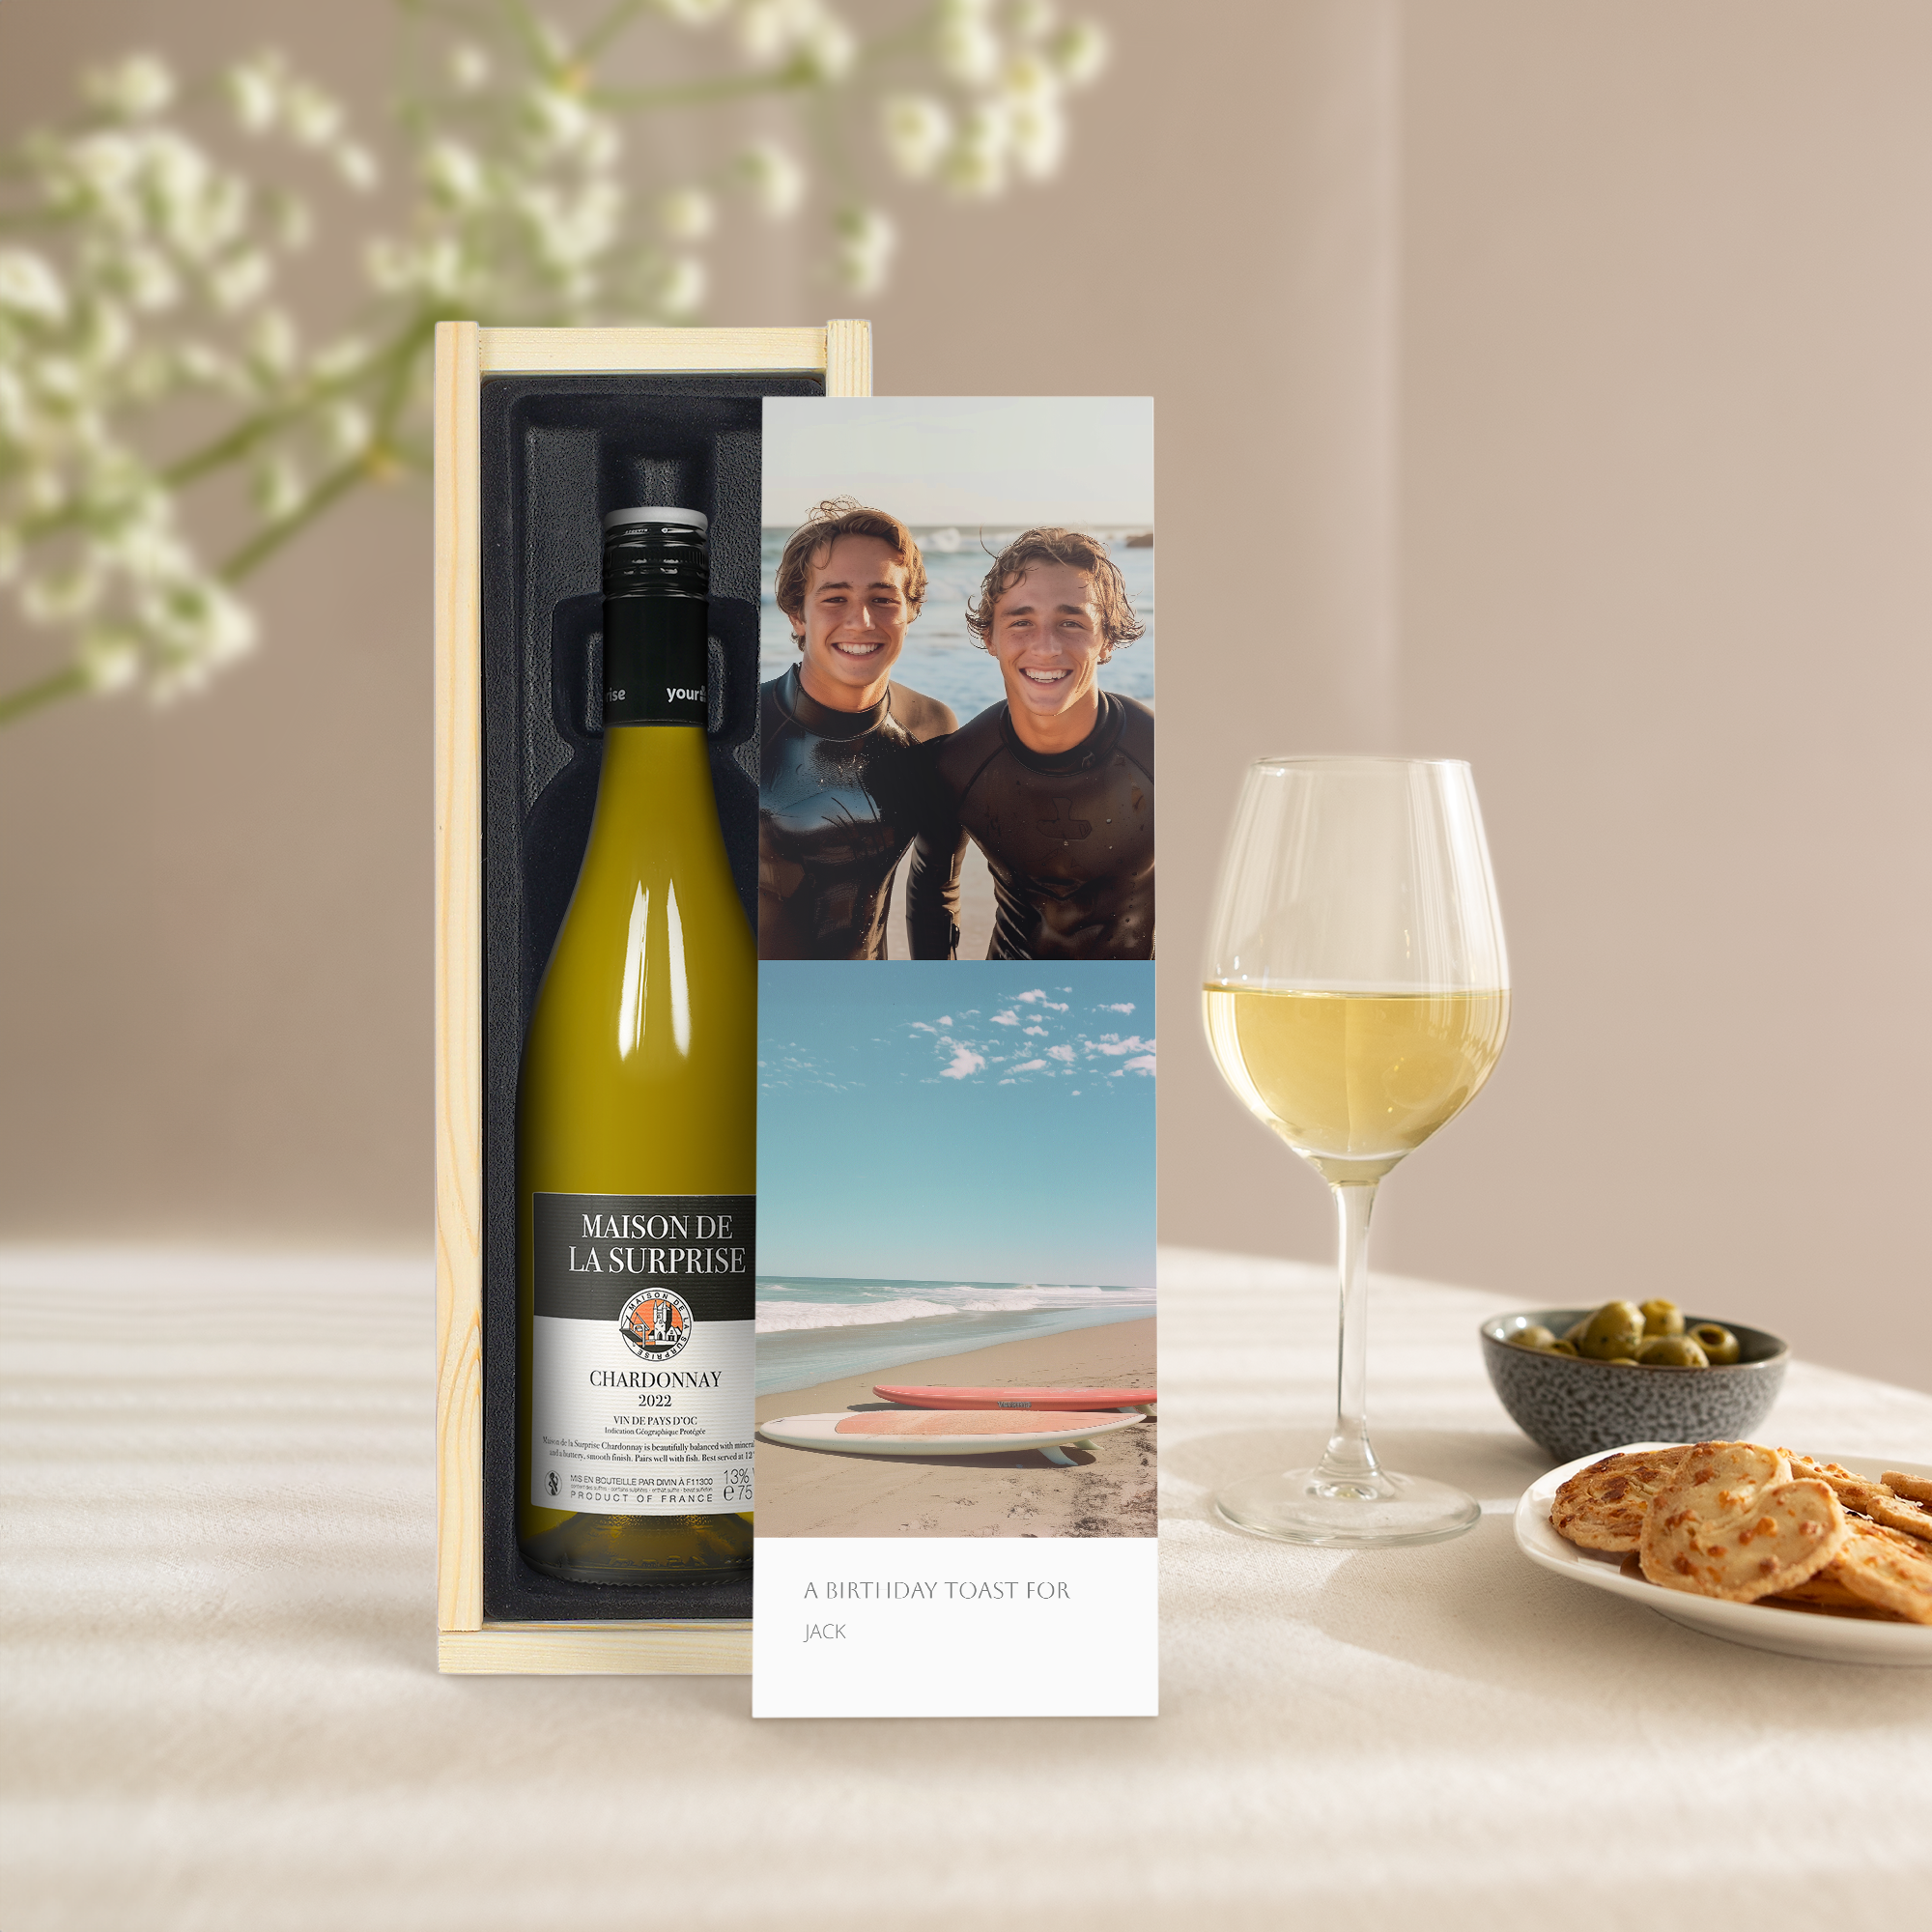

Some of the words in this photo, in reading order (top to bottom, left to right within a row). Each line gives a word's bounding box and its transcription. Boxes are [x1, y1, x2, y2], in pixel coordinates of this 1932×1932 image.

[667, 687, 700, 703] your
[582, 1214, 690, 1239] MAISON
[696, 1214, 733, 1239] DE
[569, 1246, 604, 1273] LA
[609, 1247, 746, 1274] SURPRISE
[628, 1293, 668, 1311] MAISON
[672, 1299, 685, 1312] DE
[637, 1336, 687, 1359] SURPRISE
[590, 1370, 722, 1388] CHARDONNAY
[639, 1394, 672, 1406] 2022
[613, 1415, 630, 1425] VIN
[632, 1416, 646, 1425] DE
[647, 1416, 671, 1425] PAYS
[636, 1428, 678, 1436] Géographique
[680, 1428, 706, 1436] Protégée
[574, 1439, 600, 1450] Surprise
[601, 1441, 642, 1453] Chardonnay
[652, 1443, 689, 1453] beautifully
[611, 1453, 633, 1462] finish.
[595, 1476, 637, 1486] BOUTEILLE
[724, 1467, 750, 1485] 13%
[570, 1491, 628, 1502] PRODUCT
[637, 1494, 653, 1503] OF
[661, 1493, 713, 1503] FRANCE
[804, 1581, 818, 1599] A
[826, 1581, 938, 1600] BIRTHDAY
[945, 1581, 1019, 1600] TOAST
[1027, 1581, 1071, 1600] FOR
[803, 1623, 846, 1643] JACK
